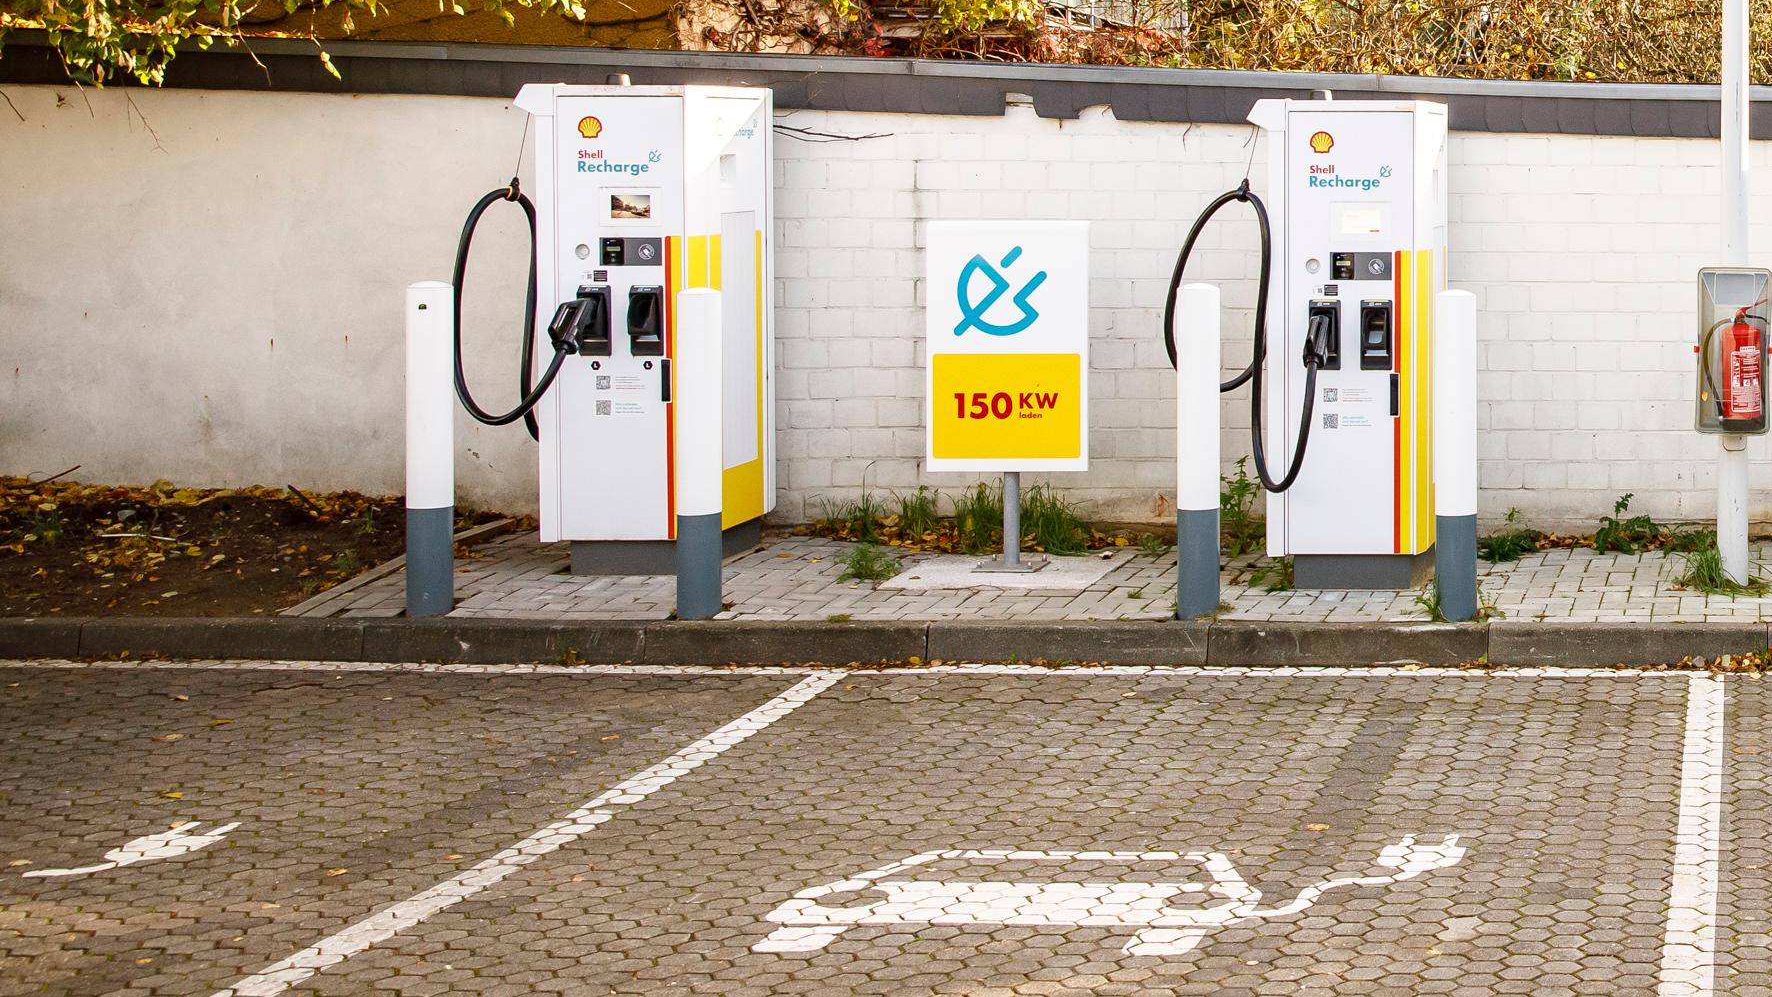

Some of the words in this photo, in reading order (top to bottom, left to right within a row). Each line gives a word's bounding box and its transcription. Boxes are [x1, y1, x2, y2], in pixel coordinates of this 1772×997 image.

[578, 150, 604, 159] Shell
[577, 160, 649, 176] Recharge
[1310, 164, 1335, 174] Shell
[1309, 175, 1381, 191] Recharge
[954, 392, 1013, 419] 150
[1019, 392, 1058, 409] KW
[1019, 411, 1043, 419] laden
